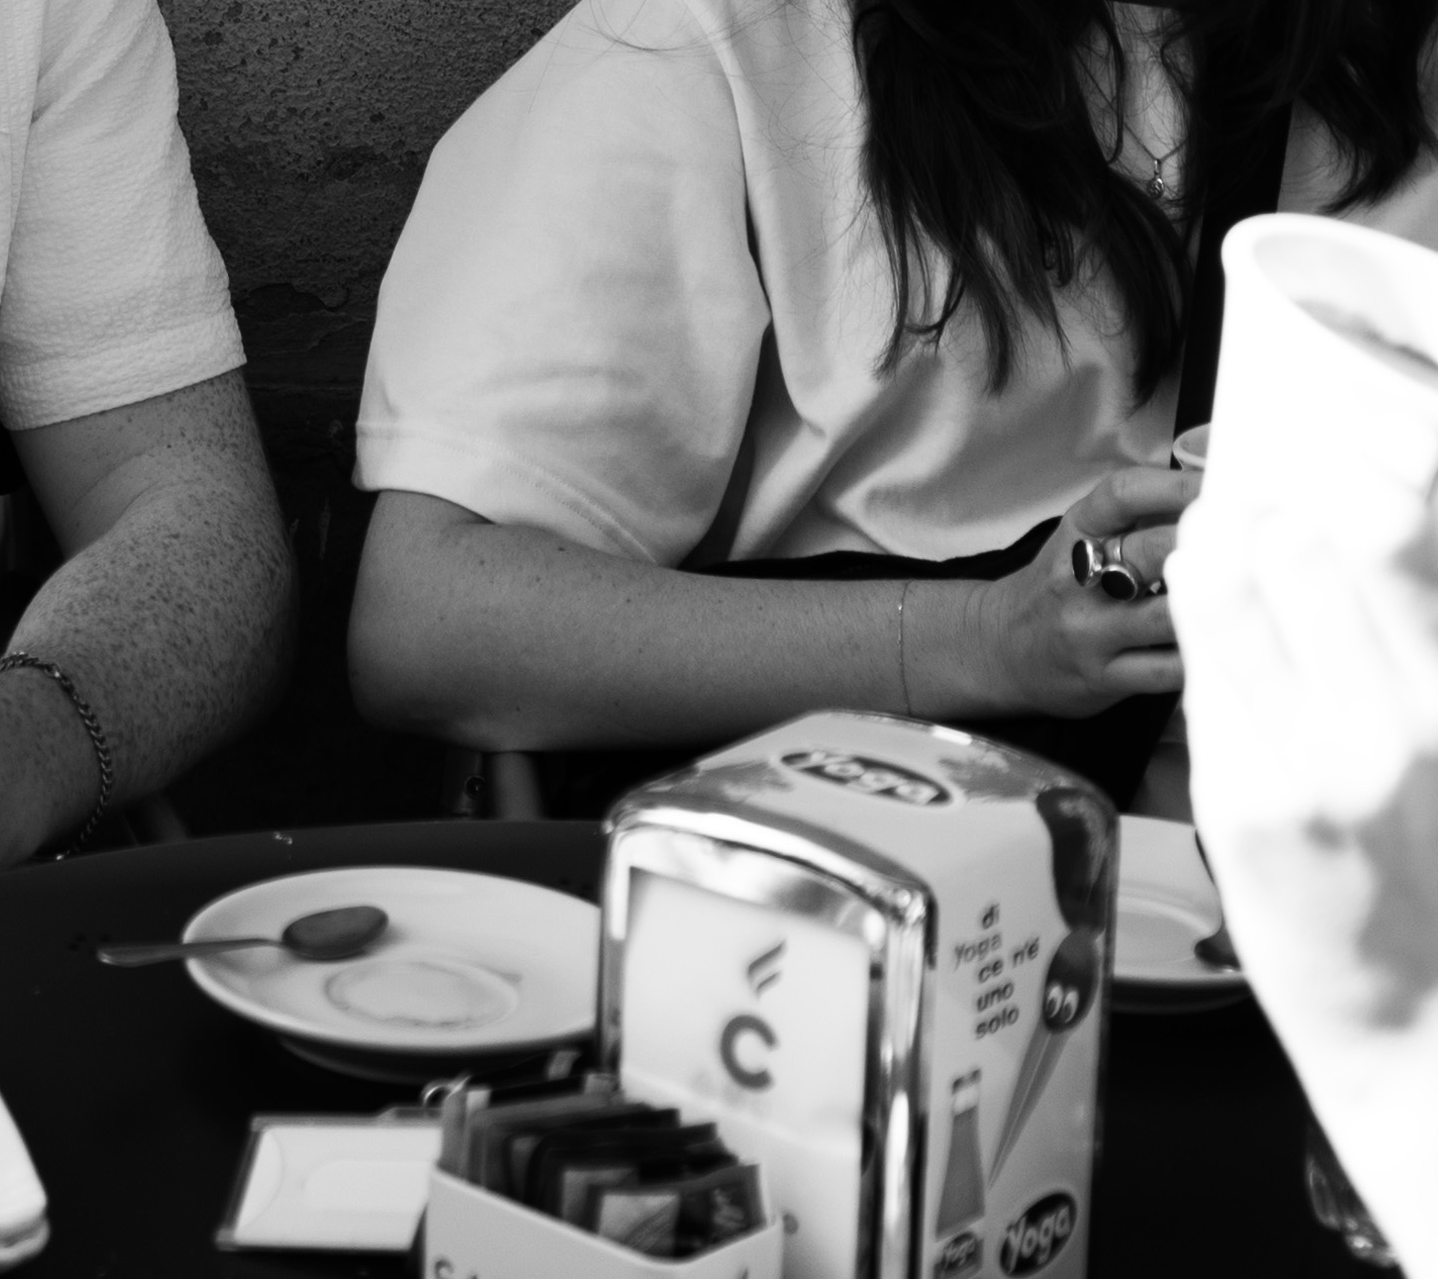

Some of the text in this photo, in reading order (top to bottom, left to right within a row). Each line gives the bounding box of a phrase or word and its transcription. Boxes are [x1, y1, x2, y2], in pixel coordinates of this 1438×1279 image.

[790, 752, 940, 805] Yoga
[982, 903, 1000, 929] di
[978, 960, 1003, 983] ce
[977, 982, 1014, 1012] uno
[976, 1007, 1019, 1039] solo
[1006, 1205, 1071, 1276] Yoga
